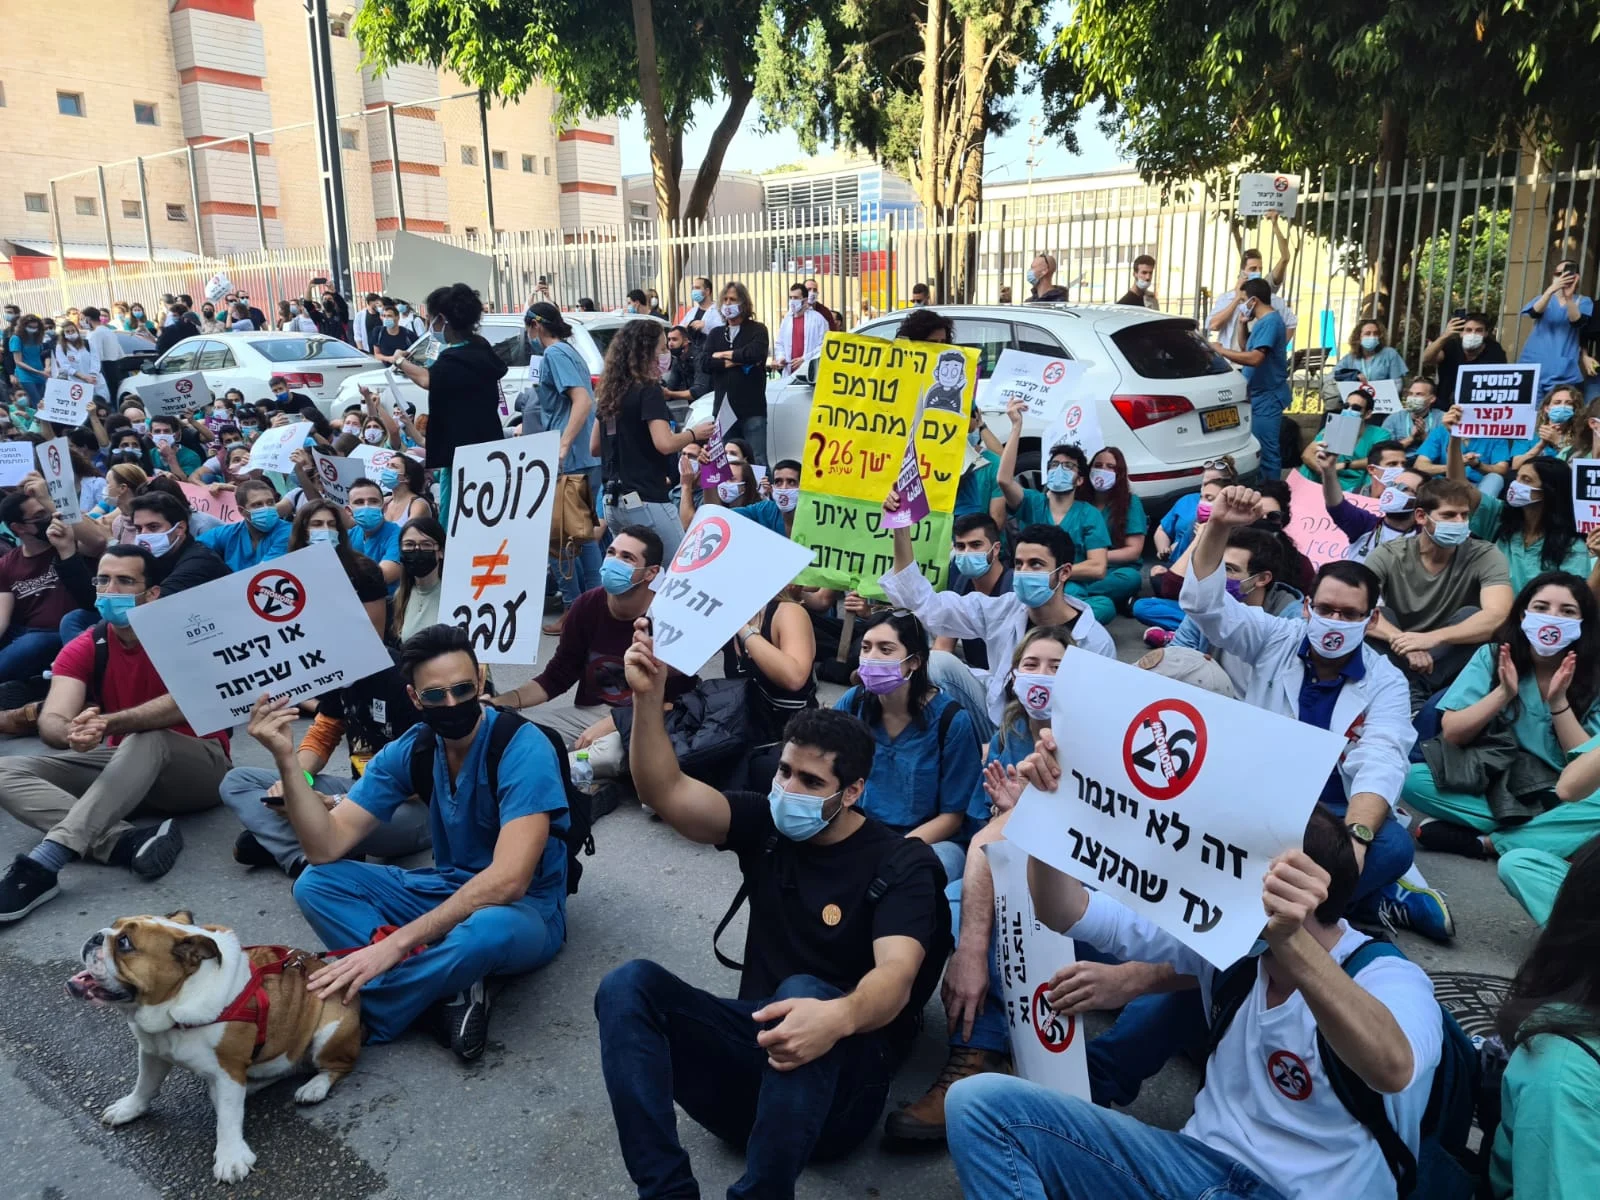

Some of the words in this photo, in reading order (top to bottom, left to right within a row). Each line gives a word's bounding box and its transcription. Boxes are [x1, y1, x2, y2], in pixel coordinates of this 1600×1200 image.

[826, 340, 882, 368] תופס
[886, 346, 928, 375] היית
[832, 371, 899, 403] טרמפ
[1015, 379, 1039, 392] קיצור
[1039, 385, 1050, 393] או
[1471, 372, 1523, 389] להוסיף
[1034, 398, 1046, 406] או
[1471, 388, 1520, 404] תקנים!
[817, 405, 907, 437] מתמחה
[1473, 406, 1513, 422] לקצר
[922, 419, 958, 445] עם
[1458, 423, 1526, 437] משמרות!
[811, 500, 857, 530] איתו
[659, 577, 692, 601] לא
[686, 590, 724, 617] זה
[278, 622, 306, 644] או
[655, 620, 684, 647] עד
[213, 634, 272, 665] קיצור
[298, 649, 327, 670] או
[215, 660, 292, 699] שביתה
[313, 669, 345, 687] קיצור
[1132, 718, 1197, 780] 26
[1150, 721, 1176, 780] #NOMORE
[1072, 769, 1139, 821] ייגמר
[1144, 808, 1191, 852] לא
[1067, 827, 1169, 904] שתקצר
[1200, 832, 1248, 880] זה
[1179, 887, 1224, 934] עד
